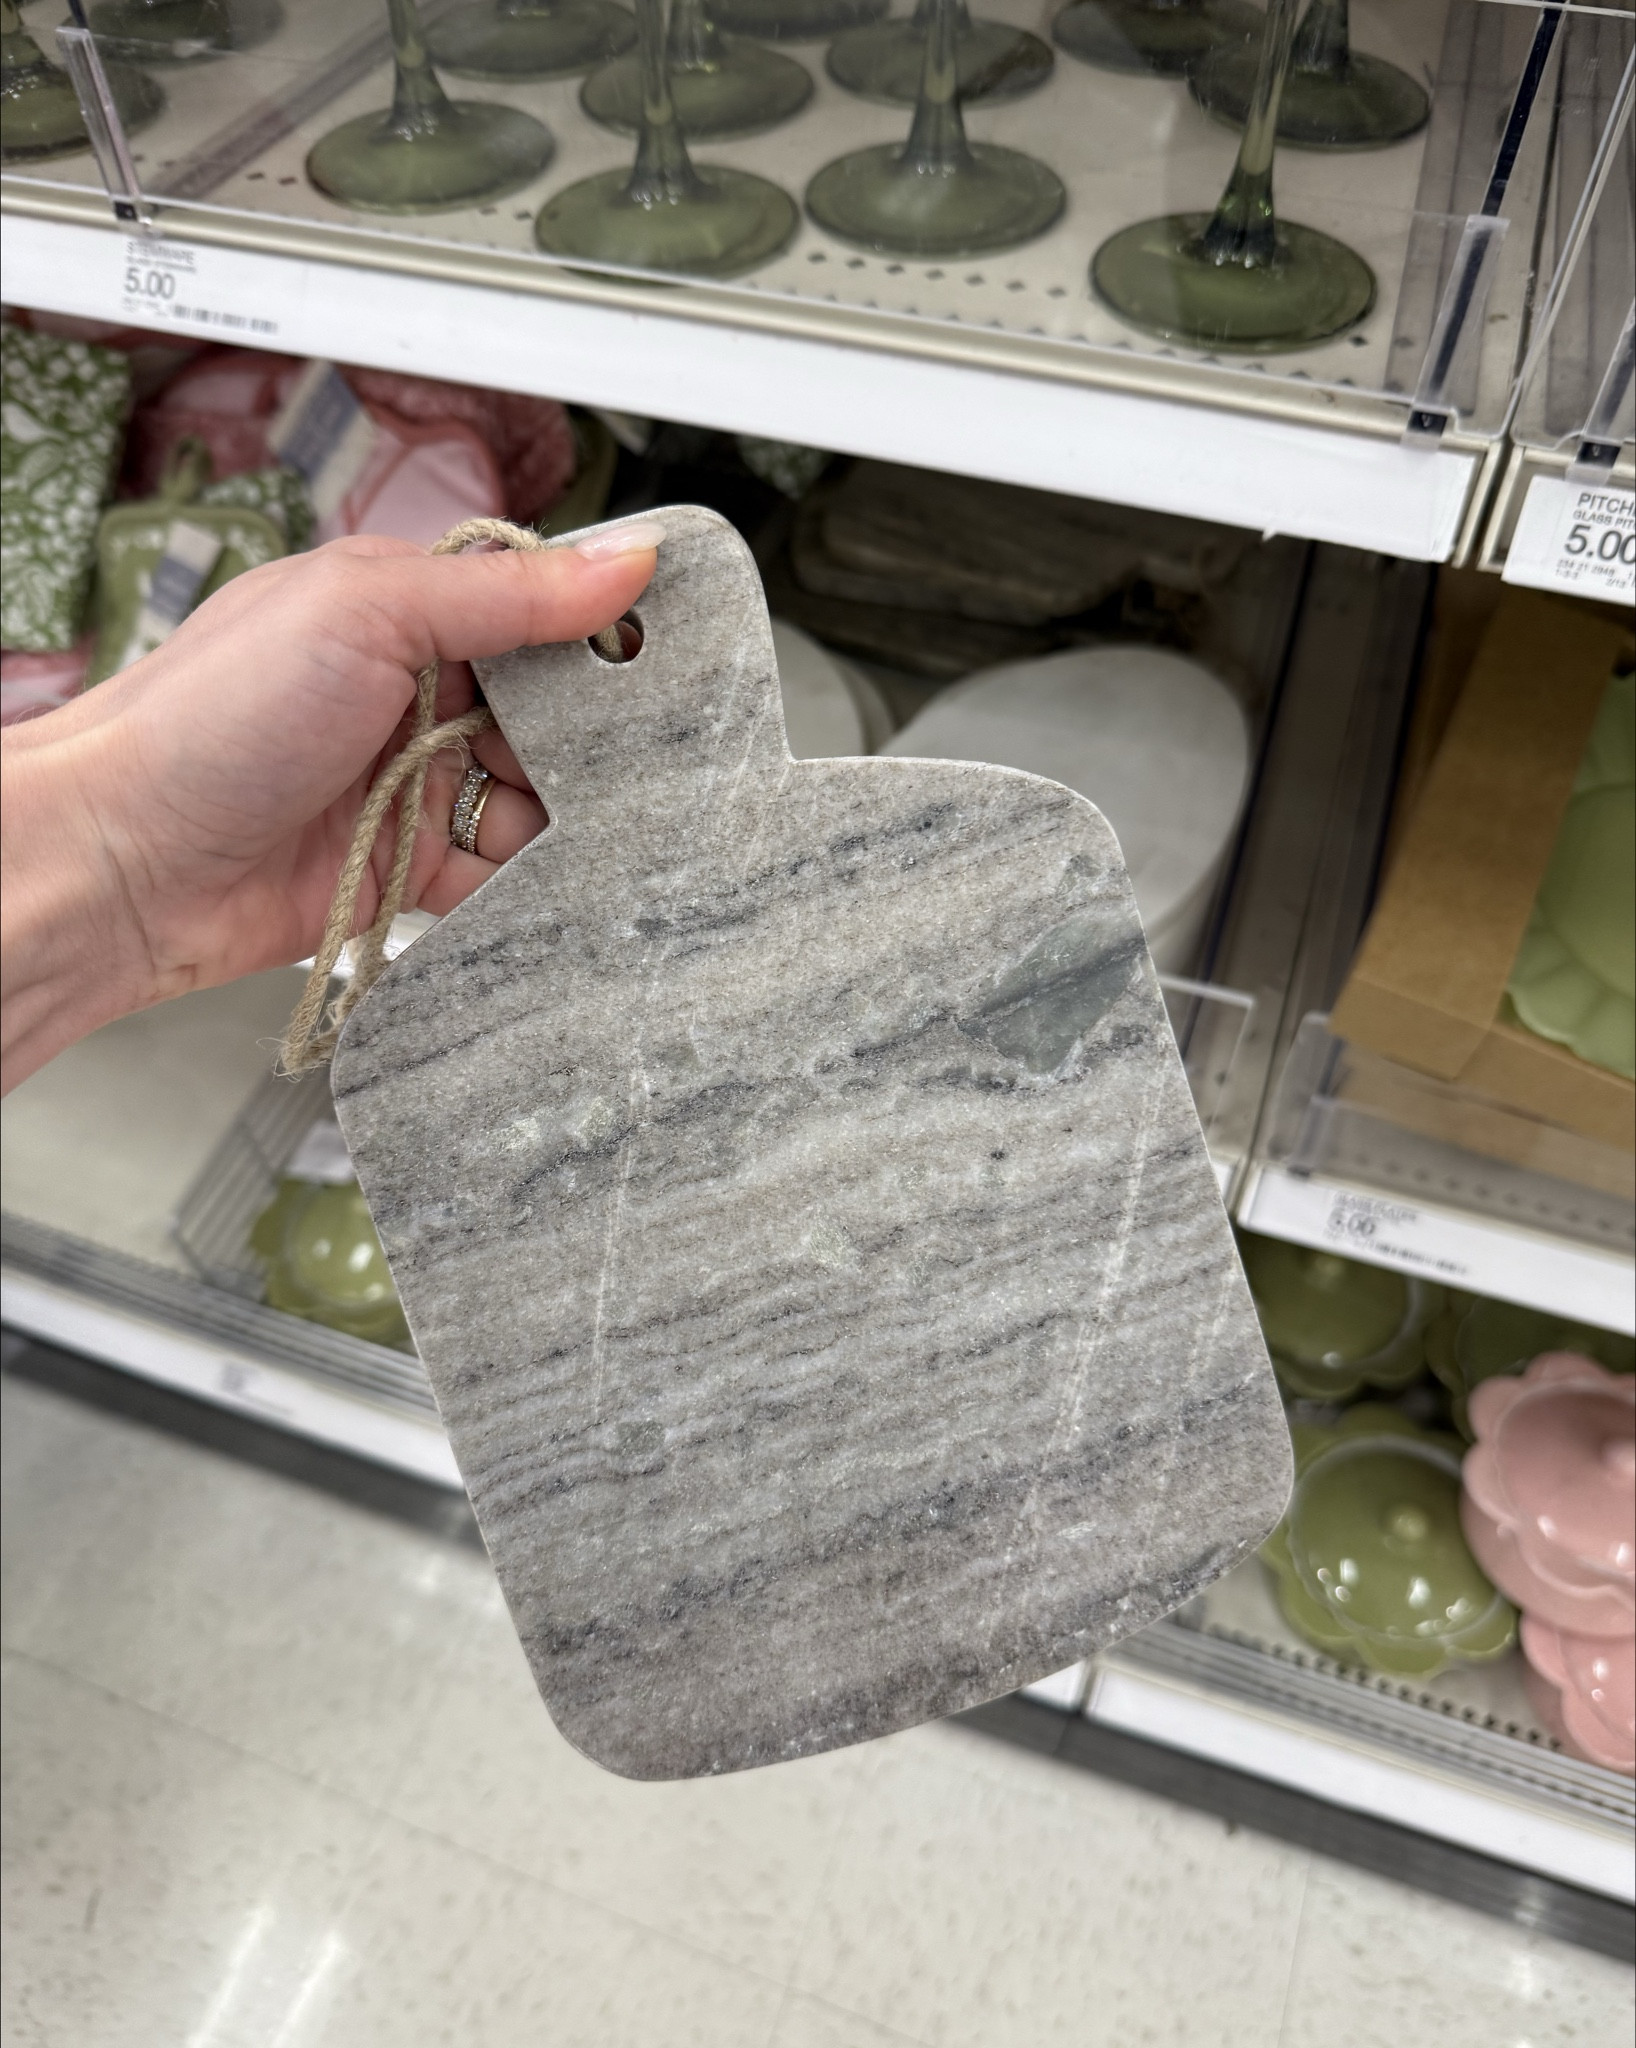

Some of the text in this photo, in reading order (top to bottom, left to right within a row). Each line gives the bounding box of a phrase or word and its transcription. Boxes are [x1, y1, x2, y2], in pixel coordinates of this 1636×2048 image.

[125, 267, 176, 299] 5.00
[1577, 491, 1635, 517] PITCH
[1573, 510, 1635, 531] GLASS PIT
